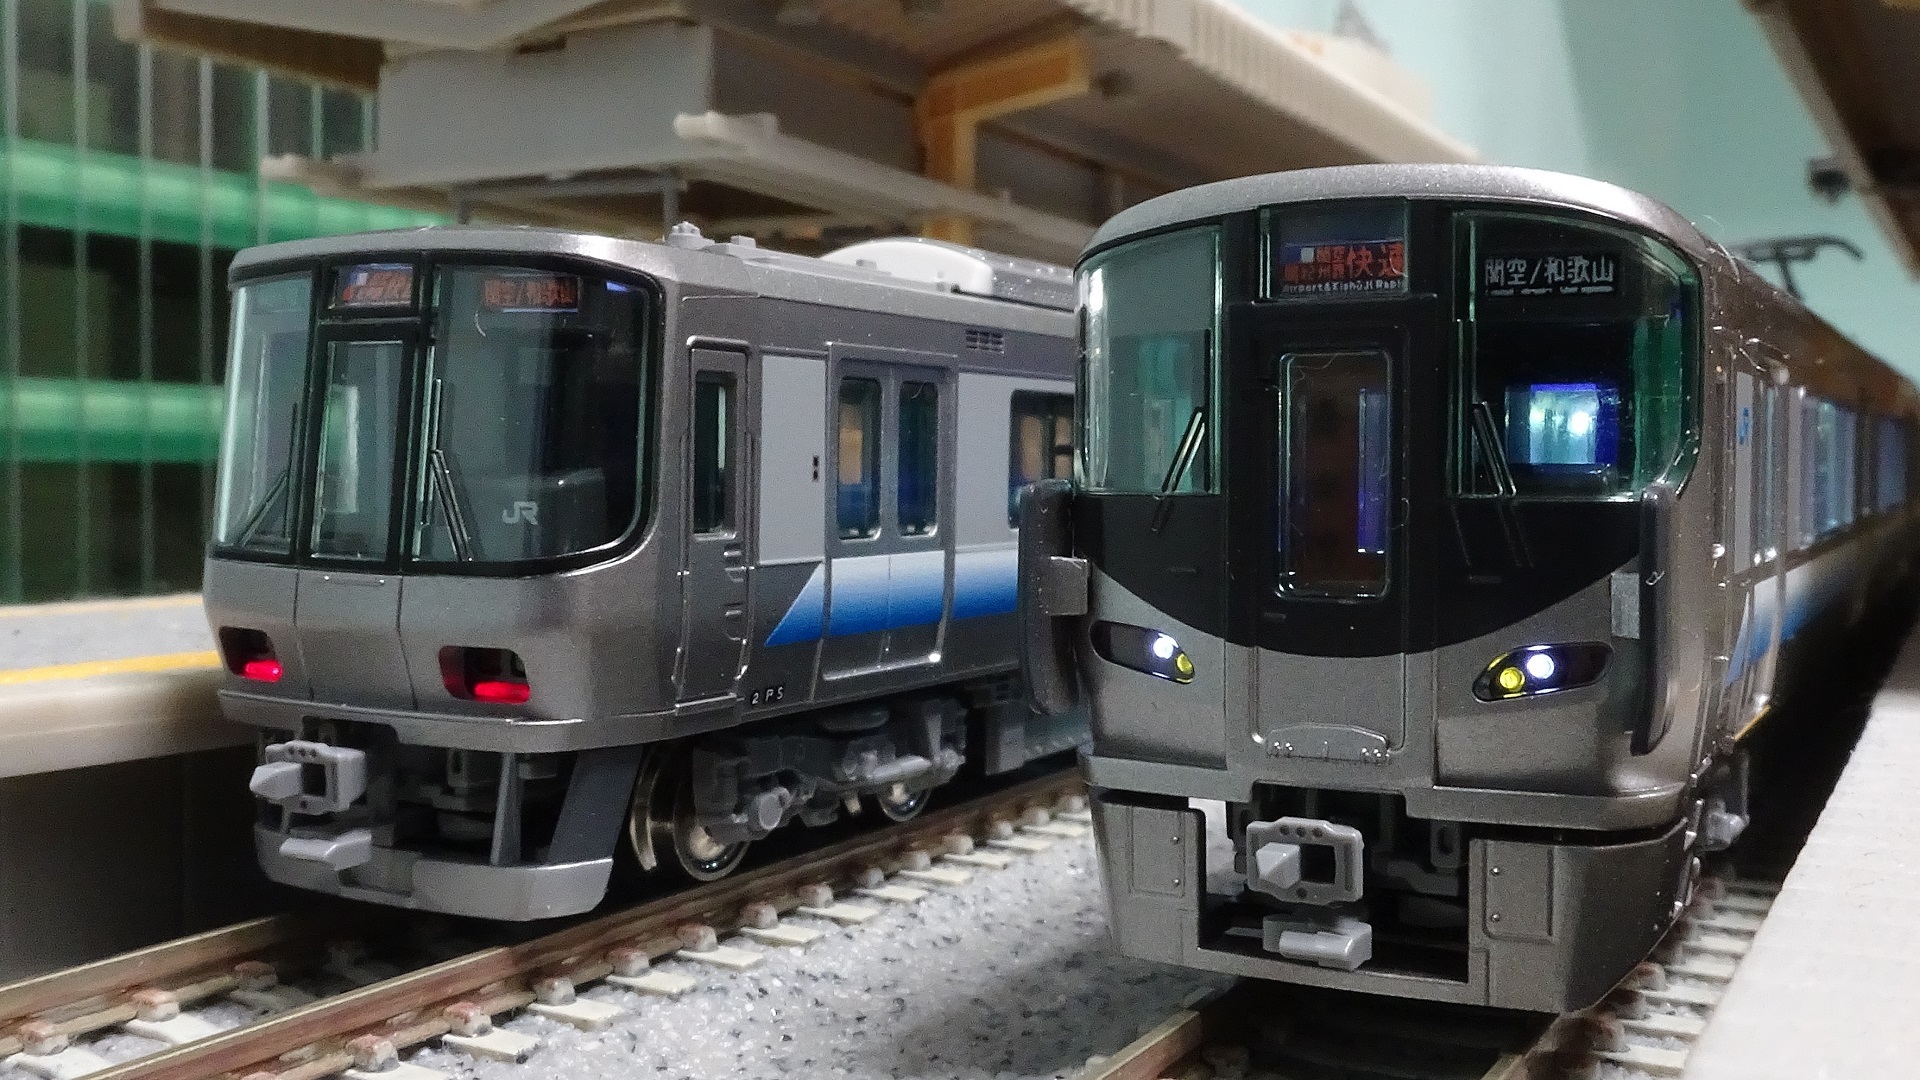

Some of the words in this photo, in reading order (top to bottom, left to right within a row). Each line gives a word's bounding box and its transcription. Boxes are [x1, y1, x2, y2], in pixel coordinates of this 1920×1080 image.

[1485, 256, 1613, 286] 関空/和歌山
[502, 501, 539, 525] JR
